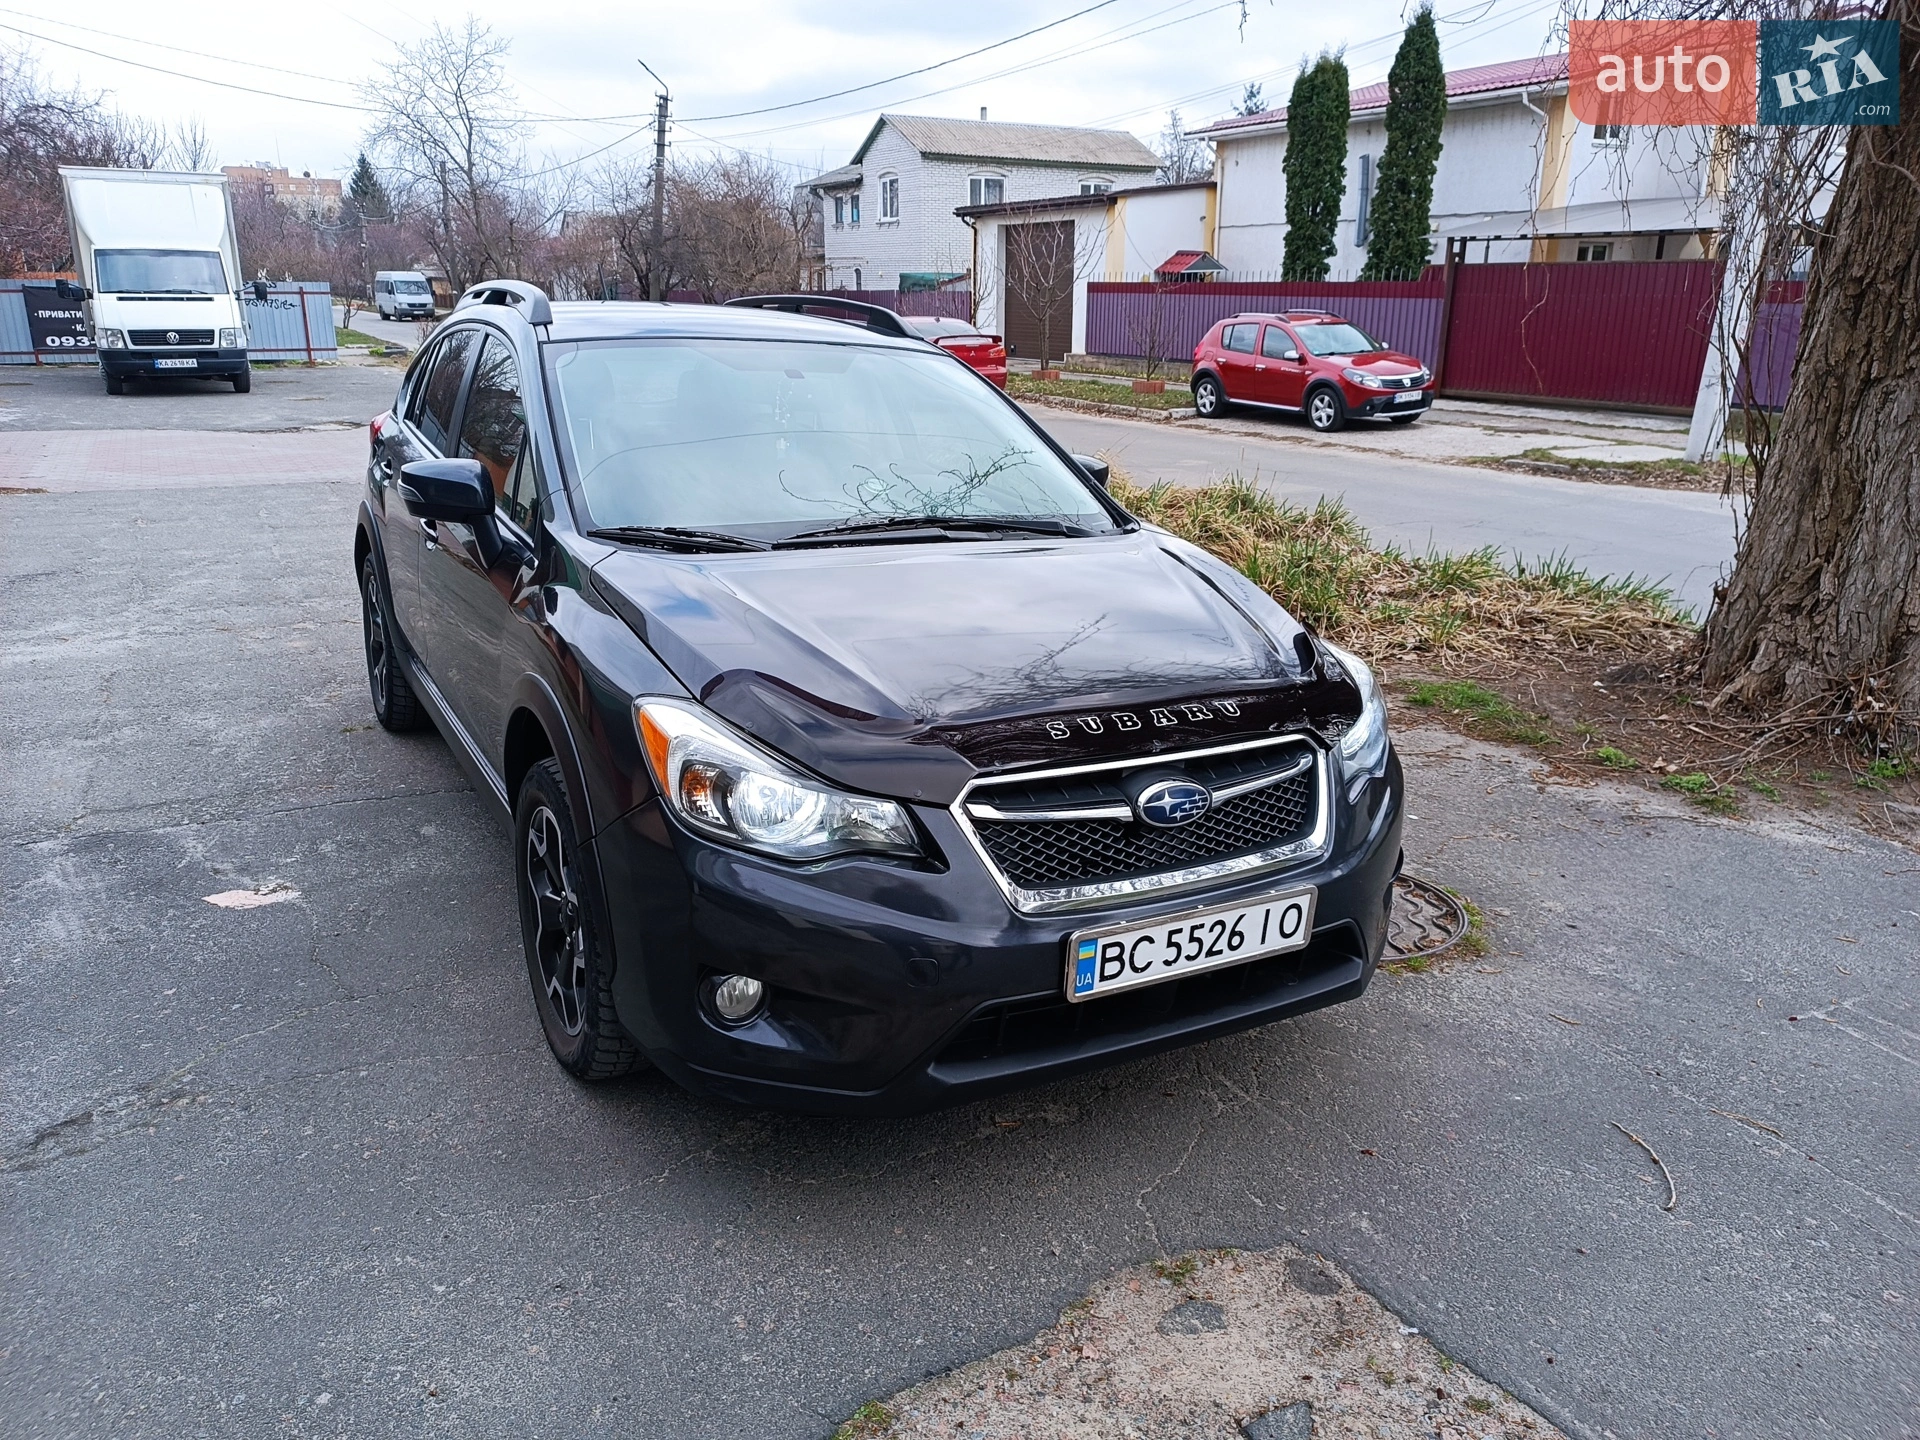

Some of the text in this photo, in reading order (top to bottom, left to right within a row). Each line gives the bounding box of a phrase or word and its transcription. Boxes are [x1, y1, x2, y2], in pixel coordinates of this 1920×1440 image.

[1046, 701, 1240, 739] SUBARU
[1098, 902, 1303, 983] BC 5526 IO
[1076, 974, 1093, 988] UA
